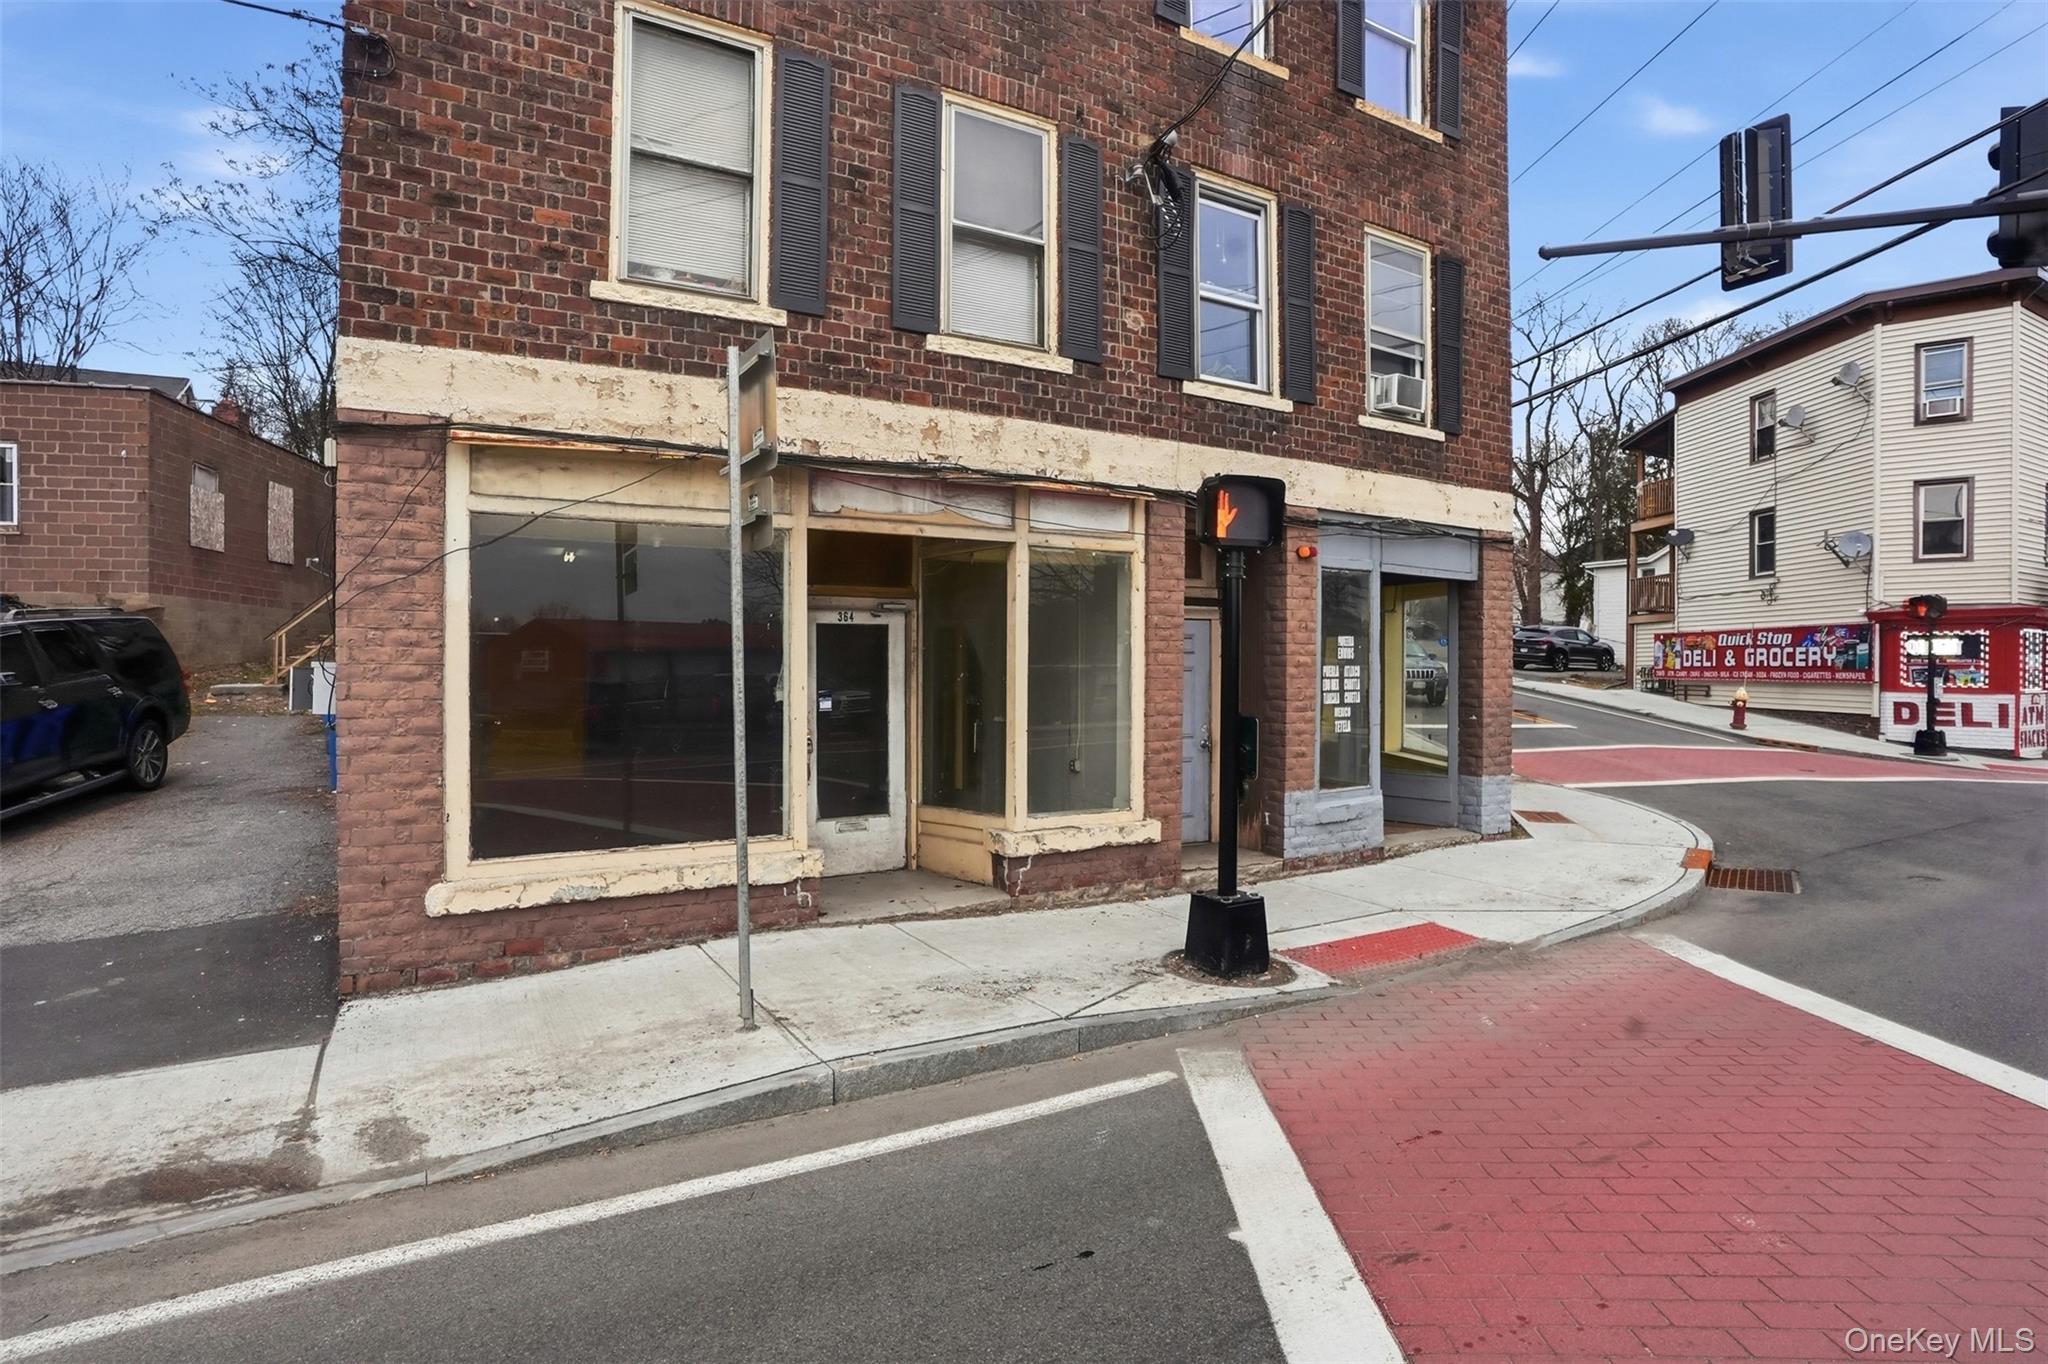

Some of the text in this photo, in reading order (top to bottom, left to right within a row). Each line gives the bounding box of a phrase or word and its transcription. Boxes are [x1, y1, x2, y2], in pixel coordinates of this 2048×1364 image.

[838, 611, 854, 622] 364
[1717, 632, 1792, 647] Quick Stop
[1683, 647, 1837, 667] DELI & GROCERY
[1835, 672, 1866, 680] NEWSPAPER
[1893, 701, 2009, 728] DELI
[2022, 705, 2044, 727] ATM
[2020, 729, 2045, 748] SNACKS
